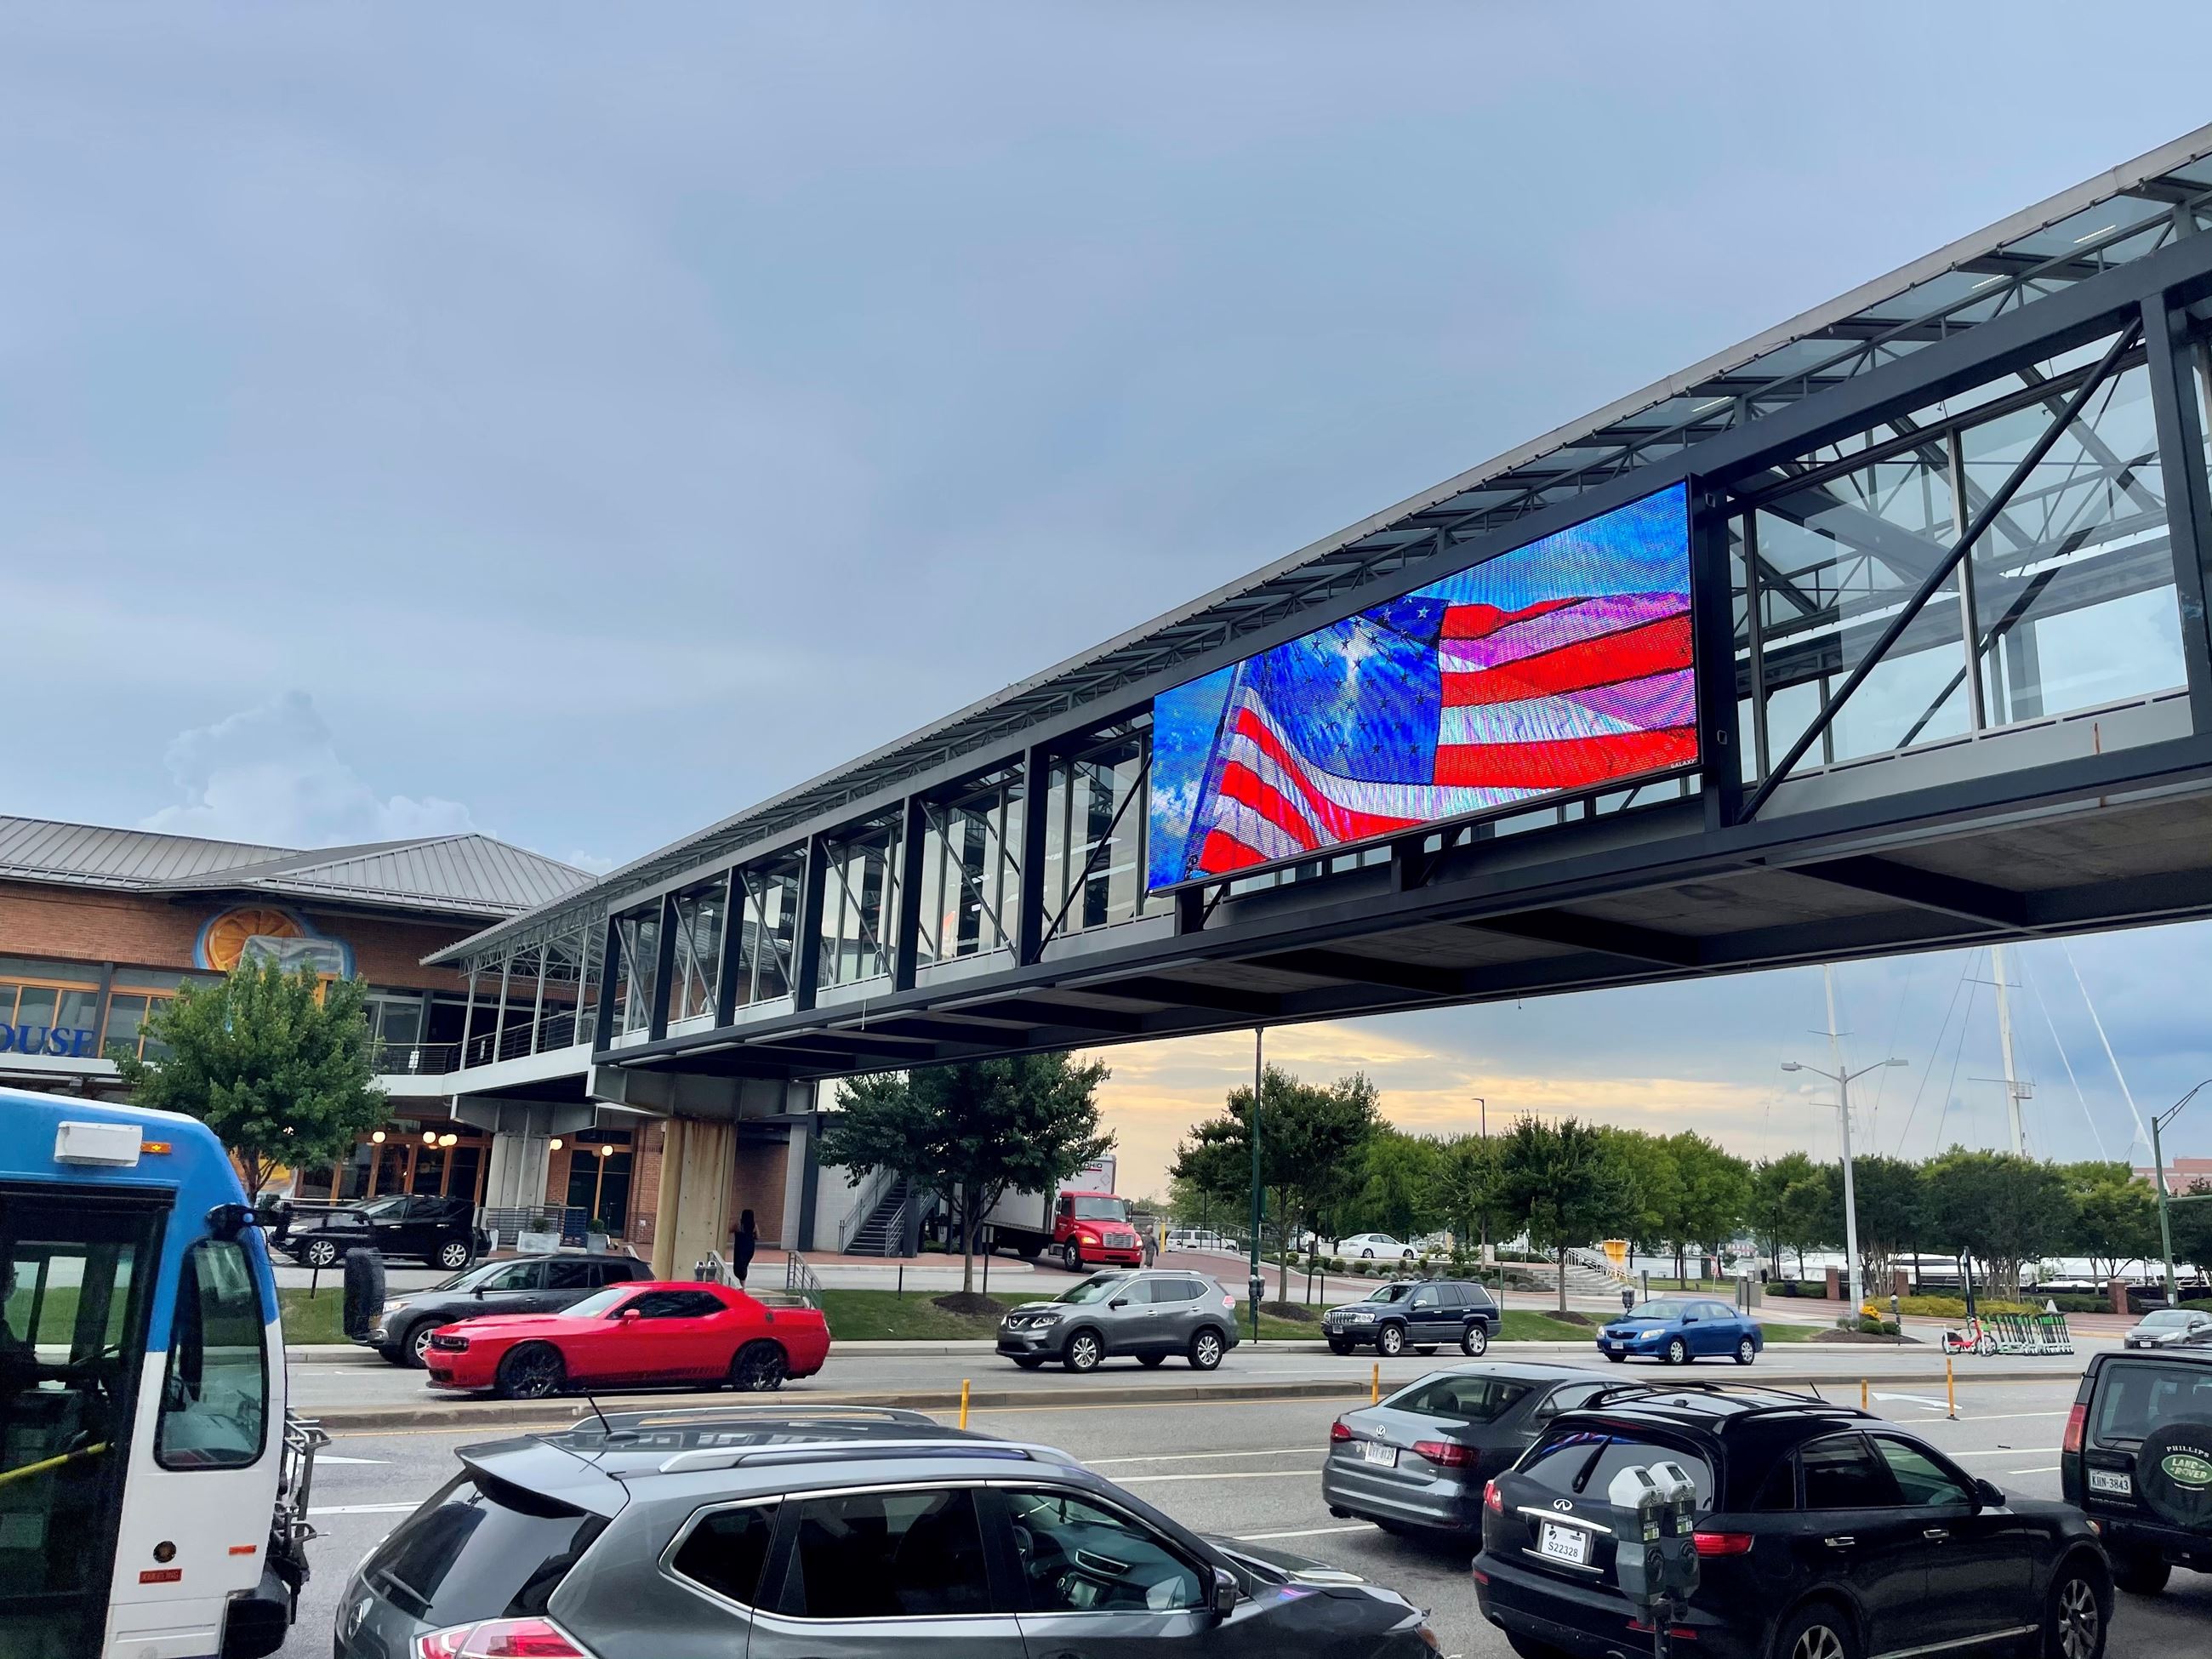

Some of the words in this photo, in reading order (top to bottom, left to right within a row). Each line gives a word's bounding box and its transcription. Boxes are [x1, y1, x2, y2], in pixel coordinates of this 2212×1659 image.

[1670, 758, 1696, 768] GALAXY
[2166, 1445, 2209, 1458] PHILLIPS
[2172, 1457, 2198, 1469] LAND
[2175, 1467, 2207, 1479] ROVER
[1548, 1542, 1578, 1558] S22328
